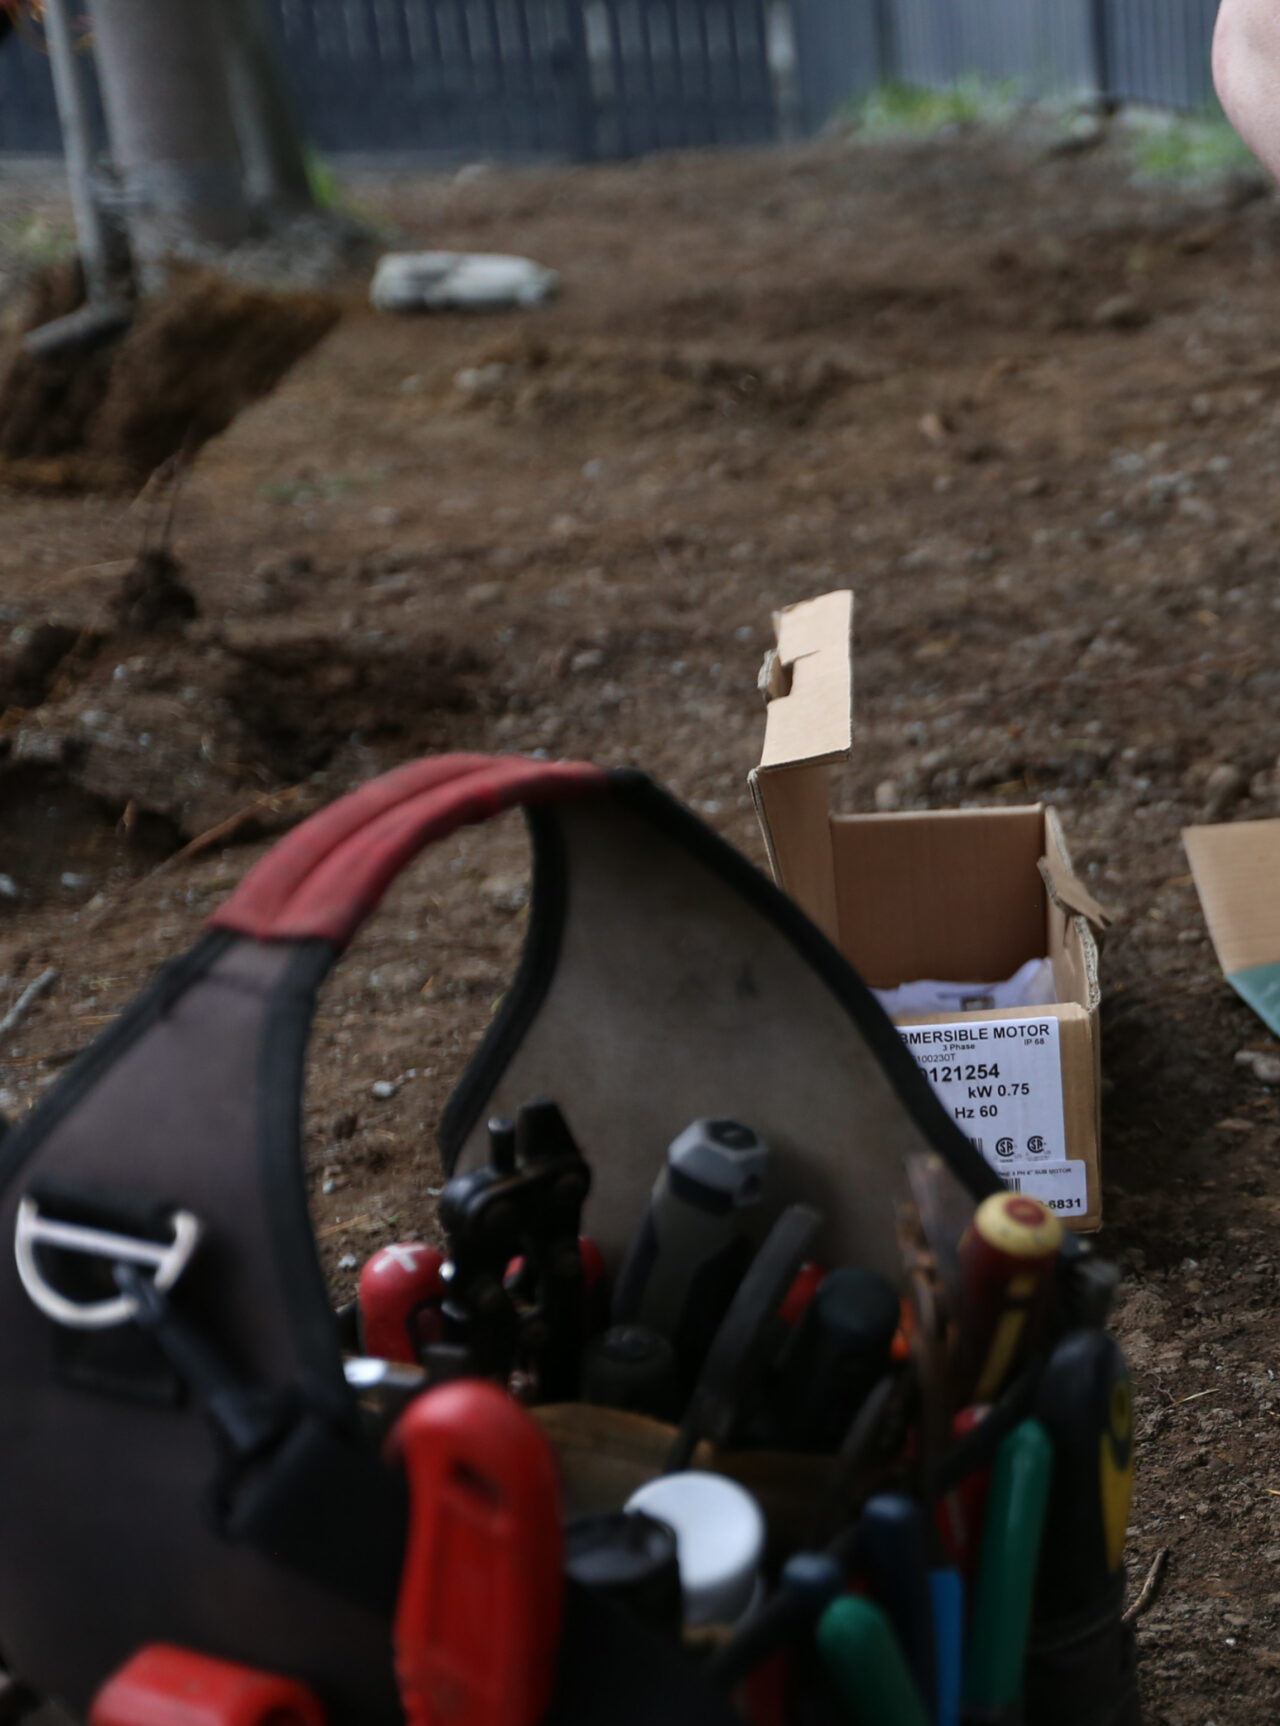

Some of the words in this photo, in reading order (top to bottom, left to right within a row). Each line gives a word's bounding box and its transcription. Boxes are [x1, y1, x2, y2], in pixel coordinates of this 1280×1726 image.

[993, 1024, 1050, 1039] MOTOR
[950, 1043, 975, 1051] Phase
[912, 1053, 955, 1063] 100230T
[968, 1086, 992, 1099] kW
[997, 1083, 1030, 1097] 0.75
[955, 1107, 974, 1119] Hz
[980, 1105, 998, 1117] 60
